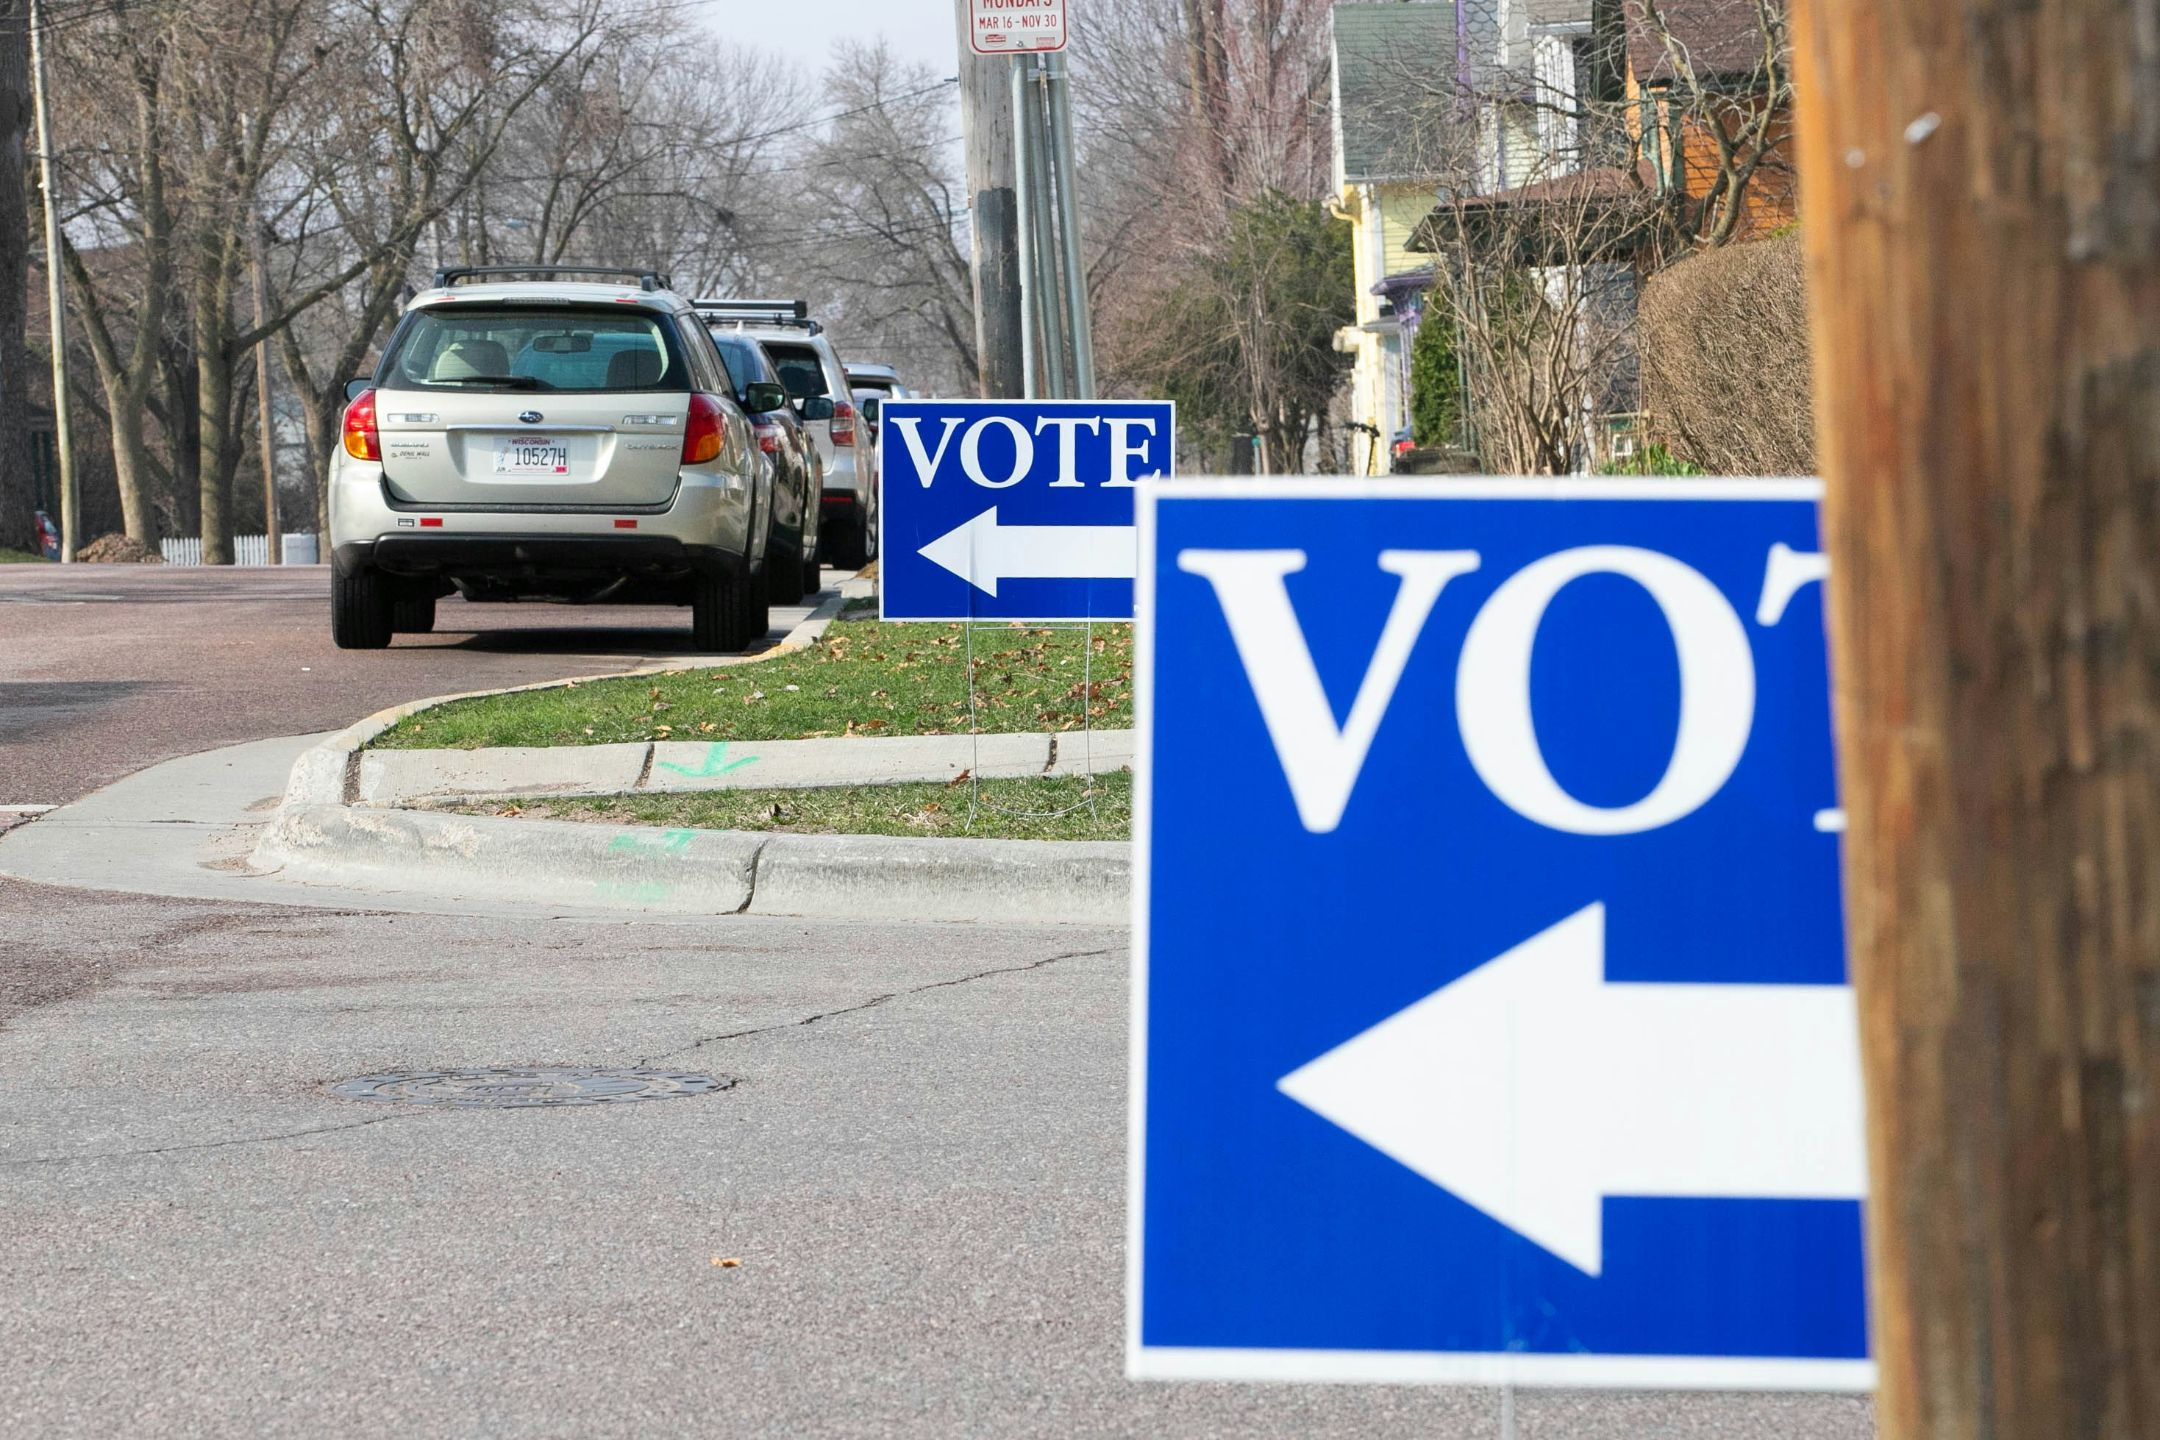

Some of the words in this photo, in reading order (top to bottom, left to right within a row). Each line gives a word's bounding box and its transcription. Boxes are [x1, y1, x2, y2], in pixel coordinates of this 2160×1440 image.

[979, 16, 999, 29] MAR
[1002, 15, 1013, 29] 16
[1022, 14, 1041, 28] NOV
[1044, 14, 1057, 27] 30
[515, 447, 566, 466] 10527H
[889, 415, 1161, 489] VOTE
